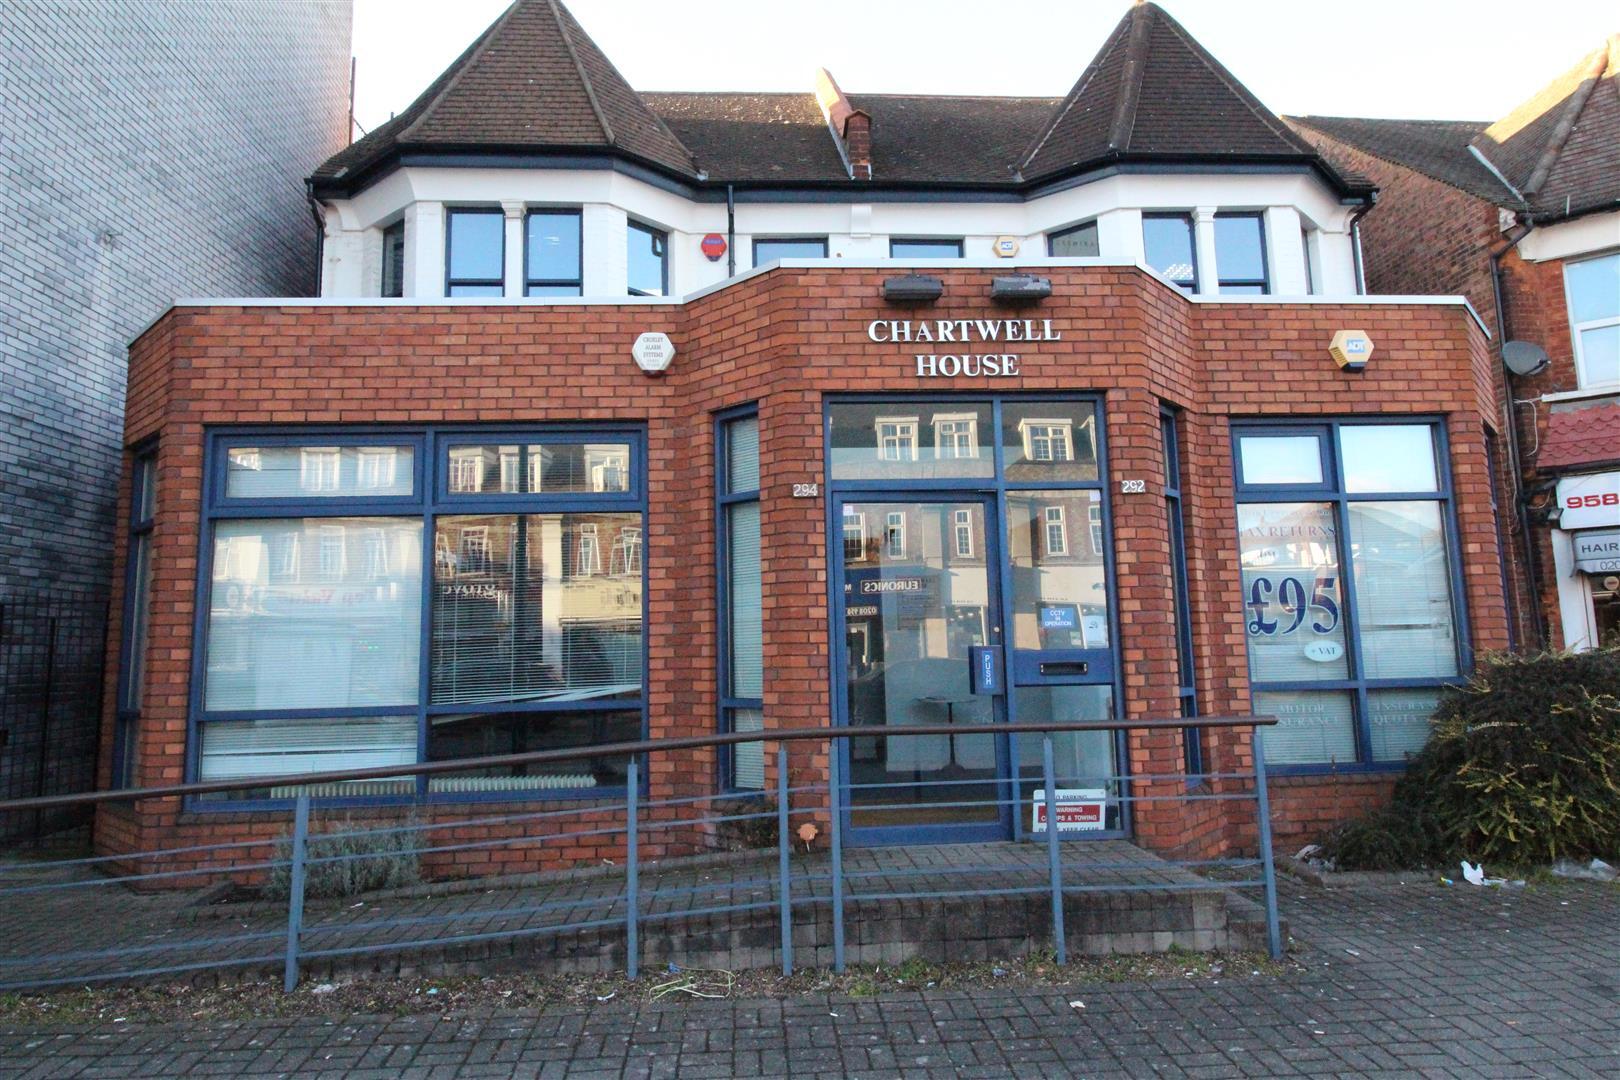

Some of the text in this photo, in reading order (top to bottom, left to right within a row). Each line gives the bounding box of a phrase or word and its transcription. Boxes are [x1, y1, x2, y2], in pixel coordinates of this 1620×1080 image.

[868, 320, 1061, 342] CHARTWELL
[1347, 341, 1365, 351] ADT
[916, 355, 1019, 377] HOUSE
[793, 484, 818, 497] 294
[1122, 480, 1146, 493] 292
[1566, 493, 1620, 509] 958
[1581, 542, 1619, 553] HAIR
[1246, 577, 1339, 635] £95
[984, 654, 992, 685] PUSH
